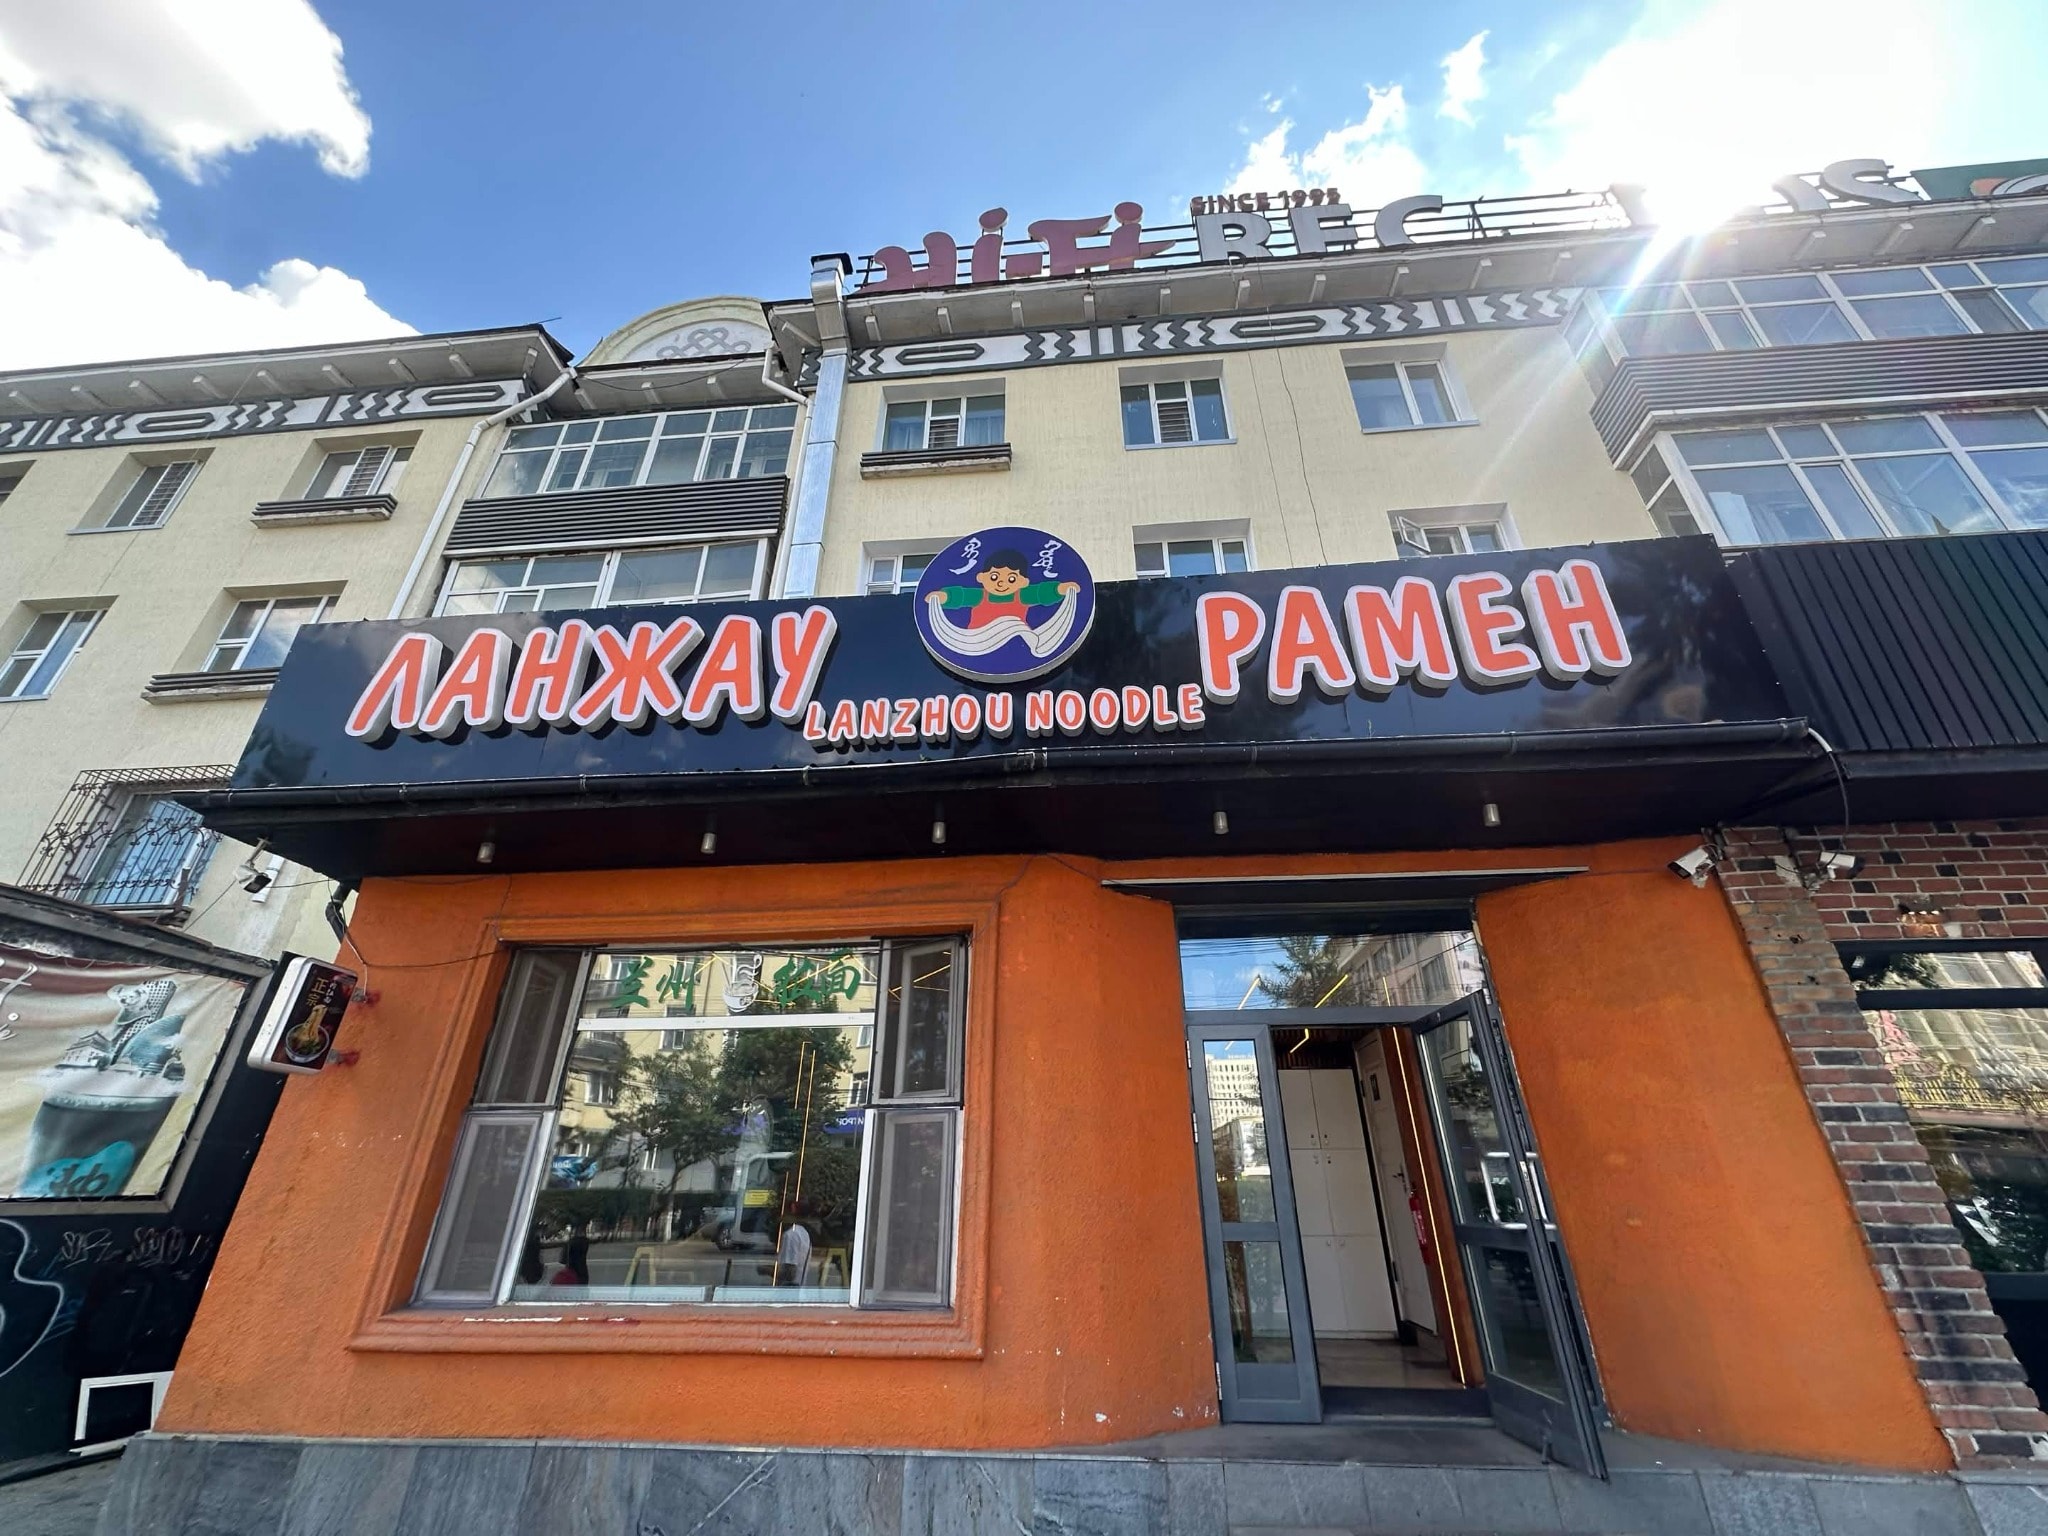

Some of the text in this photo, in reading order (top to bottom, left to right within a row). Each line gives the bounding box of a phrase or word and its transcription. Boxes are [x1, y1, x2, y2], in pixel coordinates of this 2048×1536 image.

[1190, 192, 1269, 216] SINCE
[345, 558, 1632, 738] ЛАНЖАУ РАМЕН
[803, 683, 1206, 747] LANZHOU NOODLE
